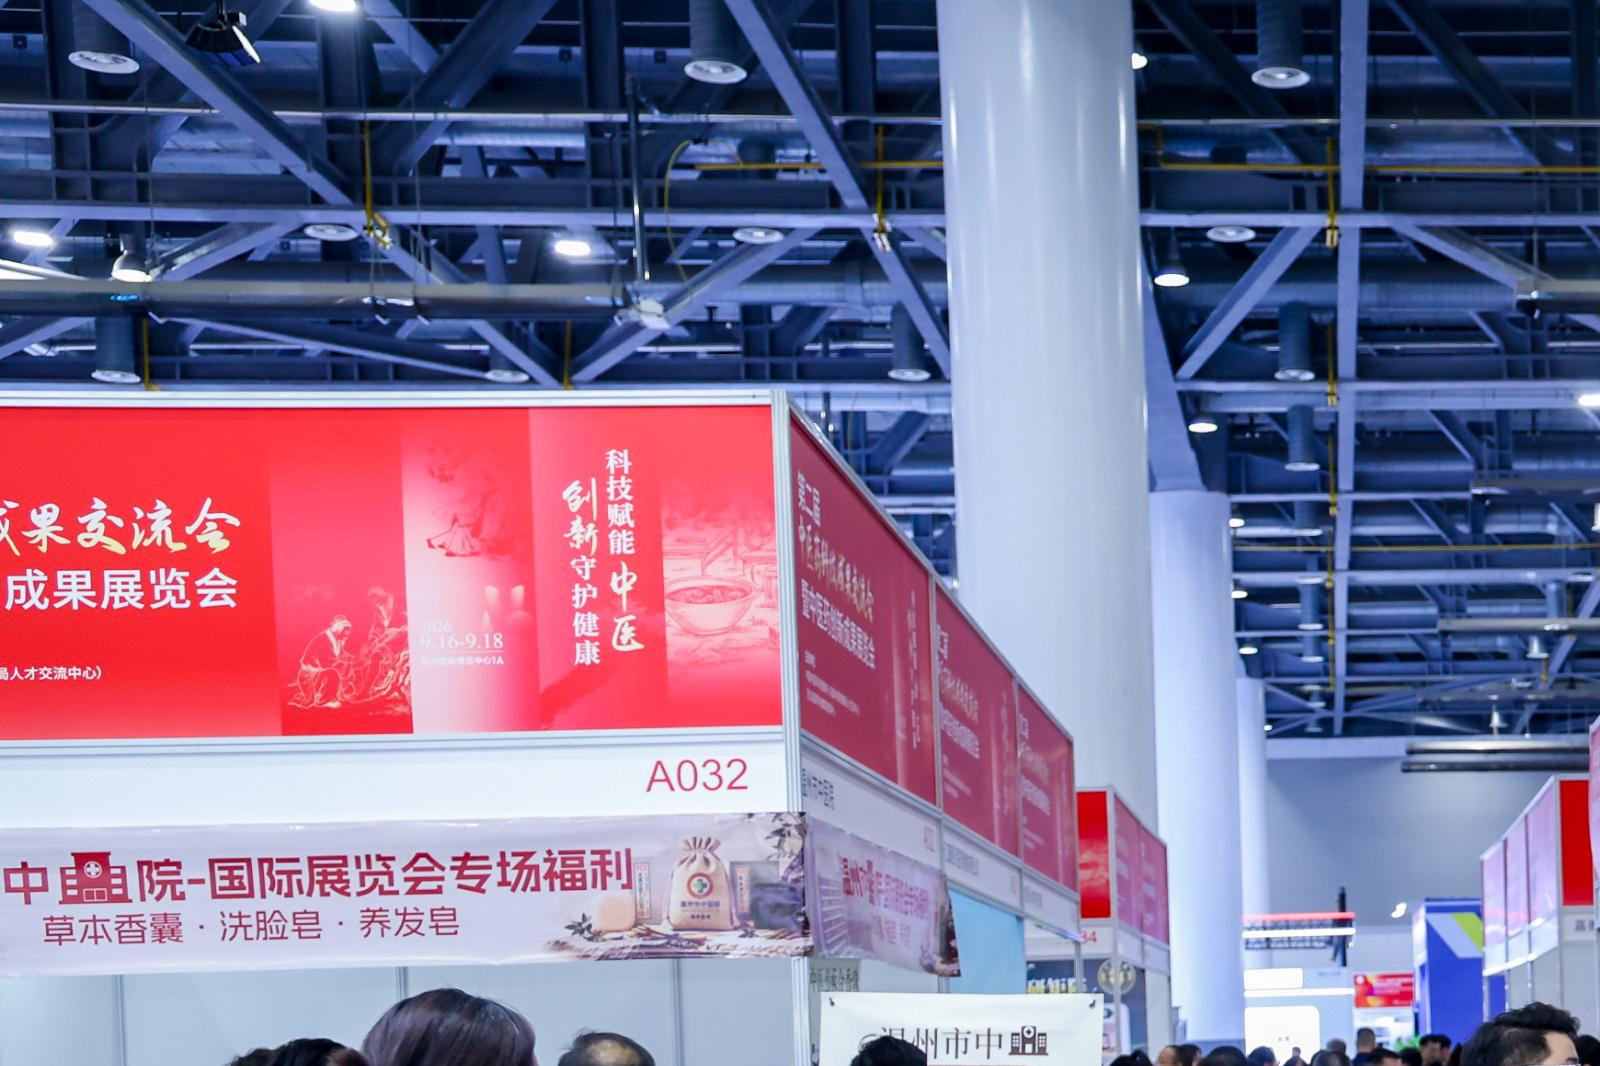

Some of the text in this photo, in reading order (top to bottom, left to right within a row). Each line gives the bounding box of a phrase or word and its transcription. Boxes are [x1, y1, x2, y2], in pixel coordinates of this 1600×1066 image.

[562, 477, 600, 666] 创新守护健康
[605, 449, 644, 652] 科技赋能中医
[5, 567, 238, 610] 成果展览会
[421, 633, 503, 649] 9.16-9.18
[646, 758, 748, 792] A032
